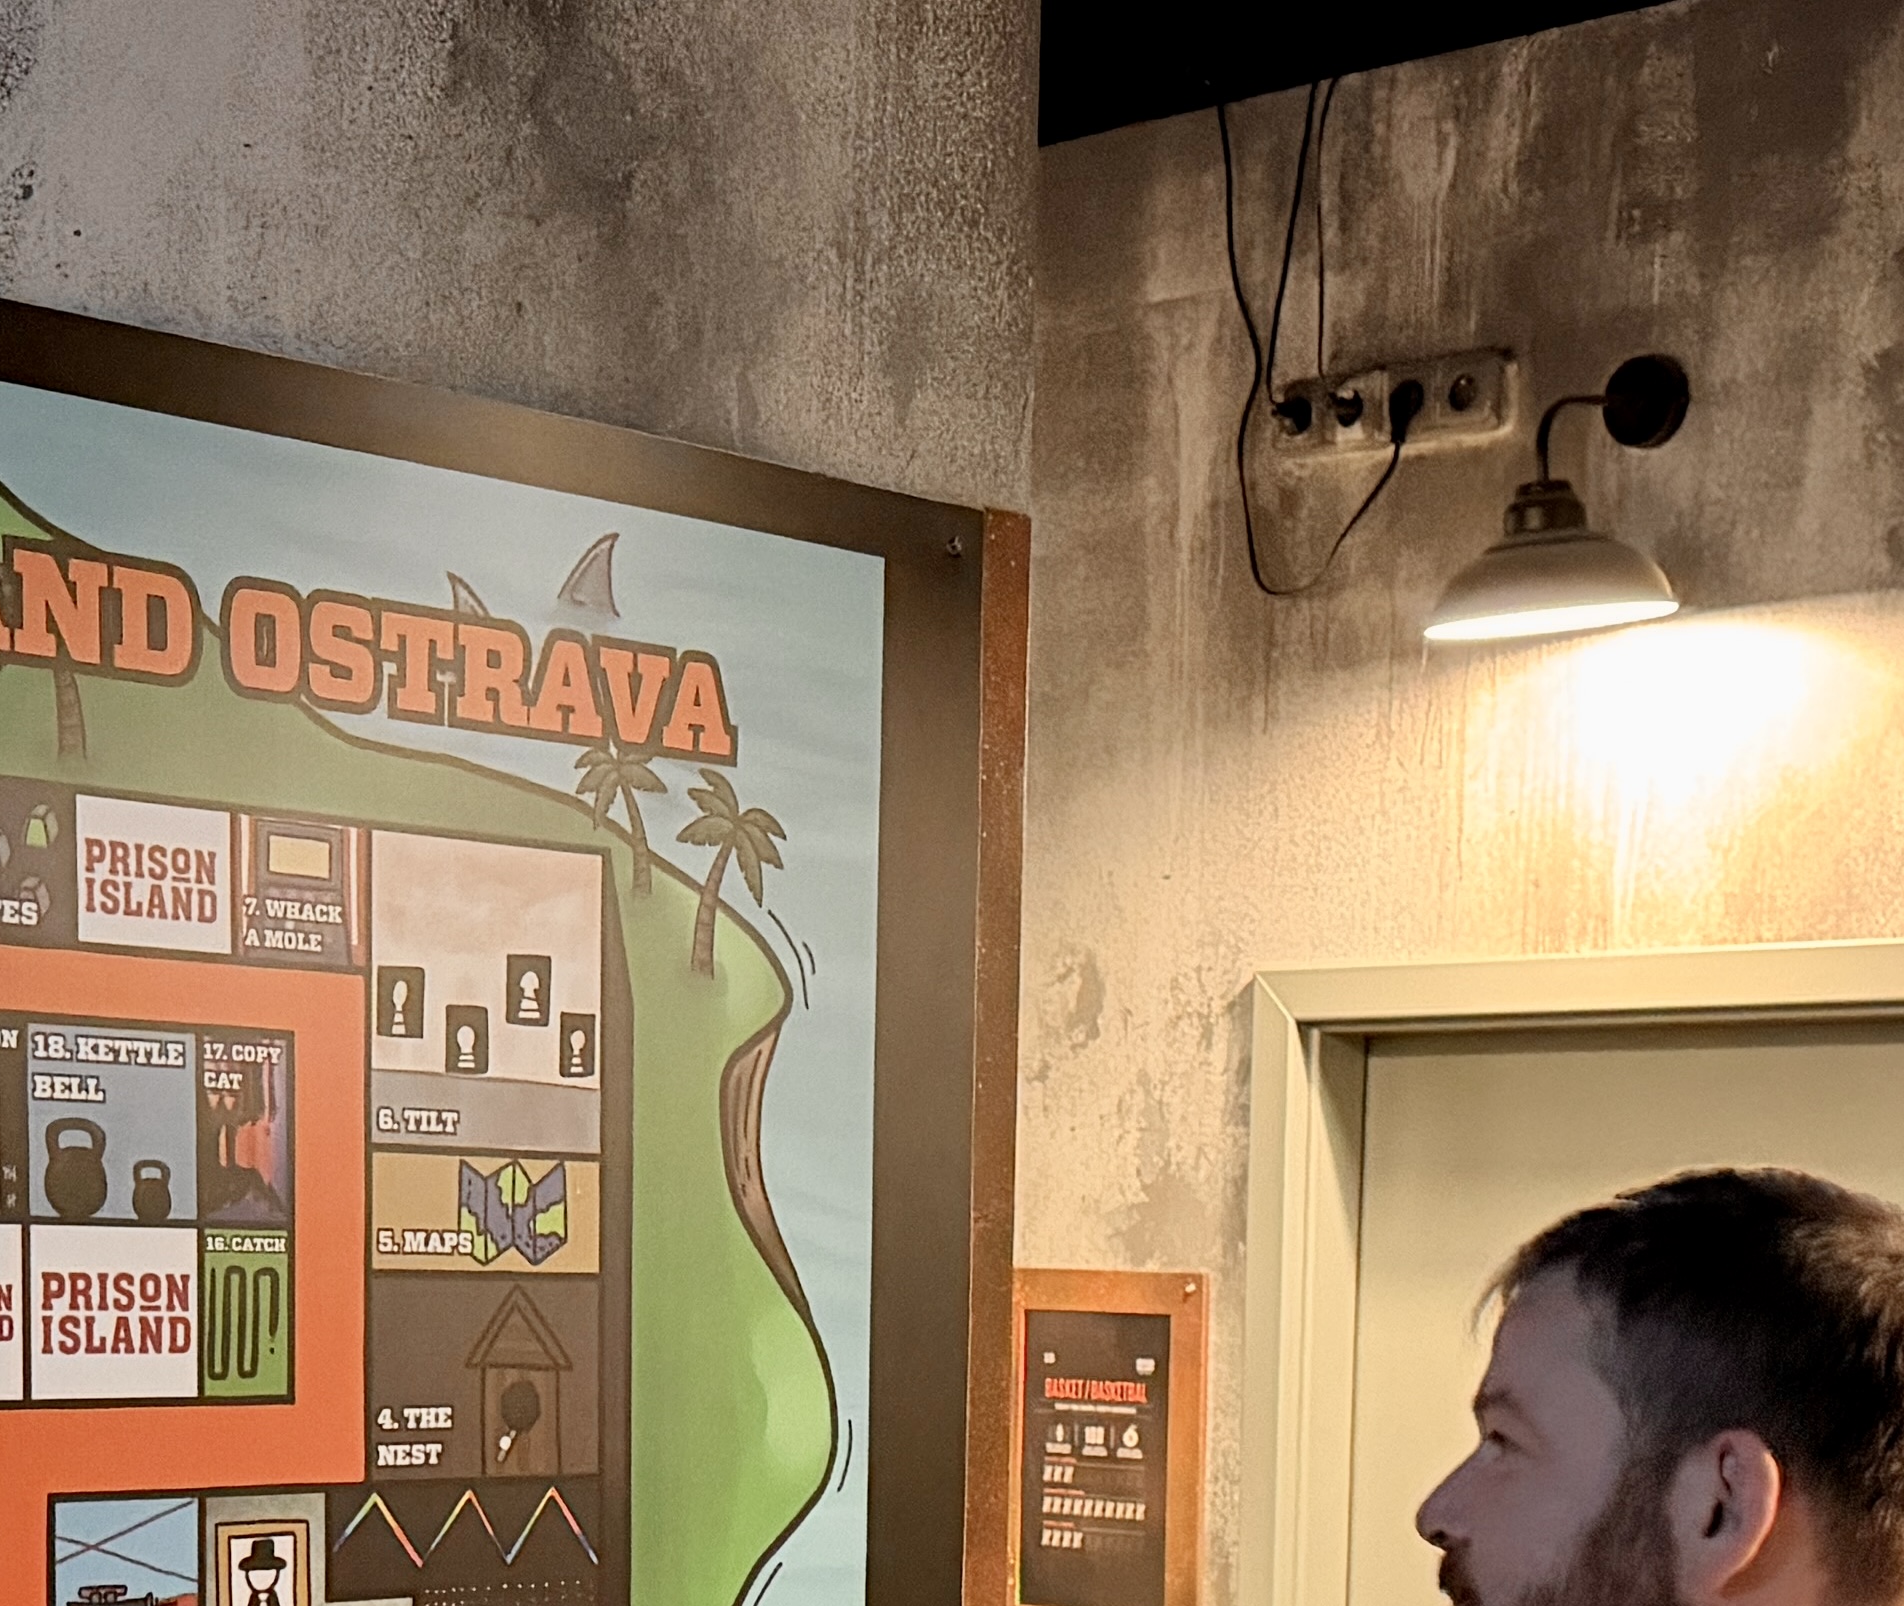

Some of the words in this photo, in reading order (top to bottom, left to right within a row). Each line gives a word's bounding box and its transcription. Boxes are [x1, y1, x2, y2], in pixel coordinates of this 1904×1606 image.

[224, 583, 737, 762] OSTRAVA
[84, 836, 218, 889] PRISON
[84, 877, 218, 926] ISLAND
[244, 896, 262, 919] 7.
[265, 899, 343, 928] WHACK
[244, 928, 264, 949] A
[267, 929, 324, 955] MOLE
[32, 1033, 73, 1062] 18.
[77, 1035, 187, 1067] KETTLE
[203, 1041, 228, 1060] 17.
[231, 1043, 283, 1065] COPY
[32, 1074, 105, 1102] BELL
[204, 1071, 244, 1092] CAT
[377, 1107, 399, 1131] 6.
[402, 1109, 460, 1135] TILT
[205, 1236, 229, 1252] 16.
[231, 1235, 288, 1255] CATCH
[377, 1231, 399, 1254] 5.
[402, 1230, 474, 1255] MAPS
[41, 1271, 192, 1314] PRISON
[41, 1315, 193, 1356] ISLAND
[377, 1408, 399, 1430] 4.
[404, 1407, 454, 1430] THE
[377, 1443, 443, 1467] NEST
